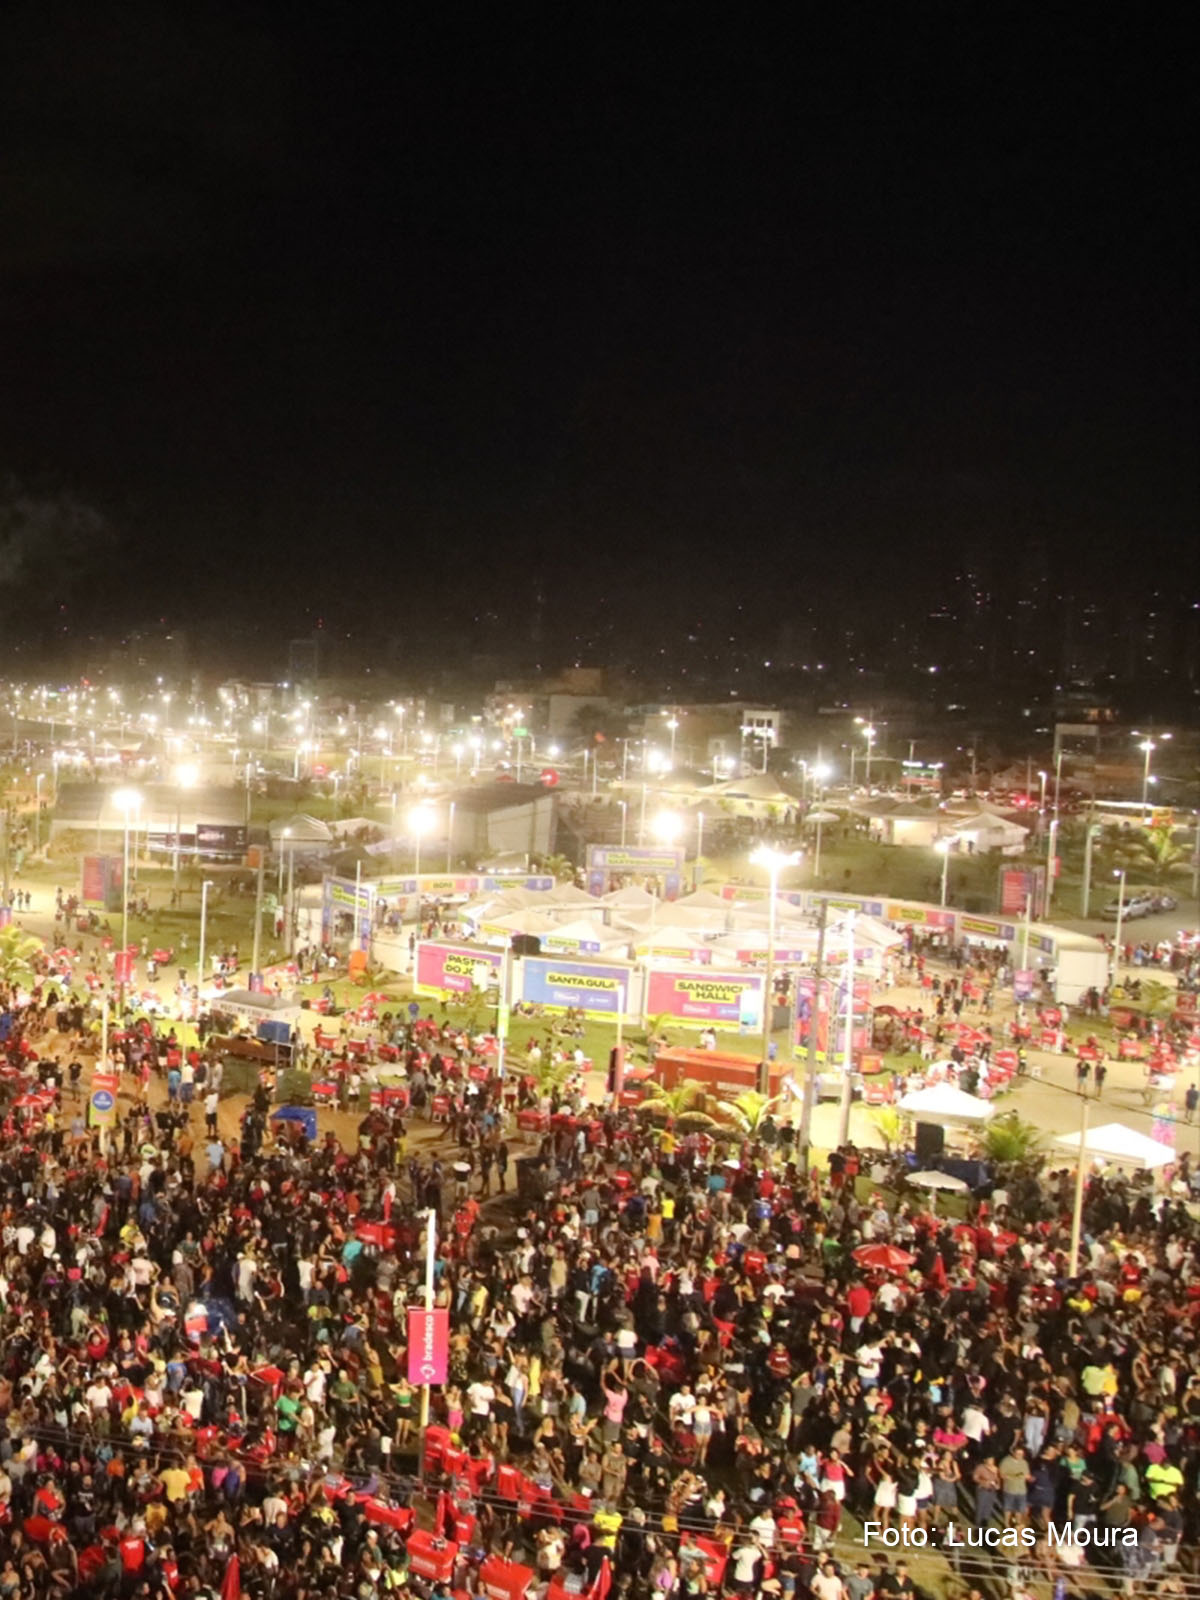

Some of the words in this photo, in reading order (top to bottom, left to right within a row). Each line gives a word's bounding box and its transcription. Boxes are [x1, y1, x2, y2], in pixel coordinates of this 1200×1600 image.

[548, 974, 585, 986] SANTA
[586, 979, 616, 989] GULA
[696, 992, 730, 1000] HALL
[423, 1315, 433, 1361] bradesco
